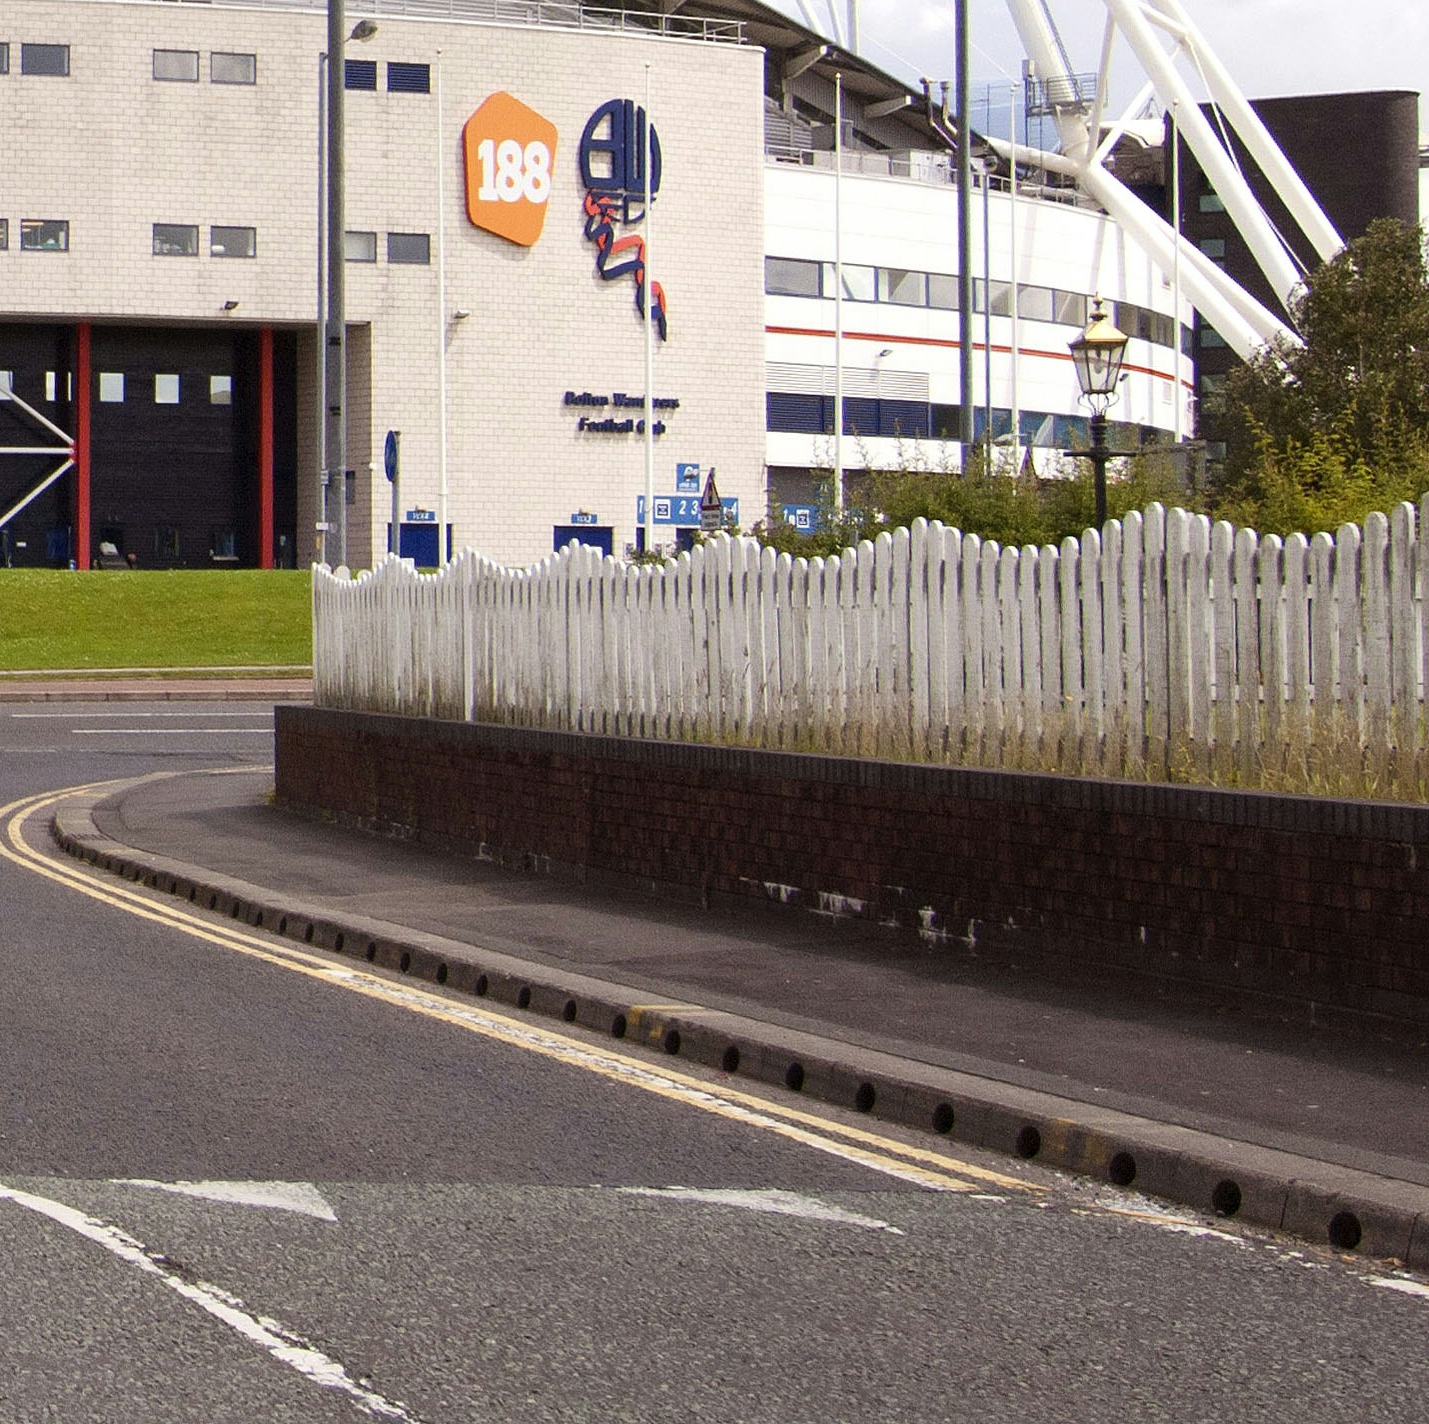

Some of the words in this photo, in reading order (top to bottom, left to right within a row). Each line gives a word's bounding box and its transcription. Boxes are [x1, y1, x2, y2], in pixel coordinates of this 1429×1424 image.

[477, 138, 551, 204] 188
[579, 417, 633, 432] Football
[678, 500, 687, 515] 2
[690, 500, 698, 515] 3
